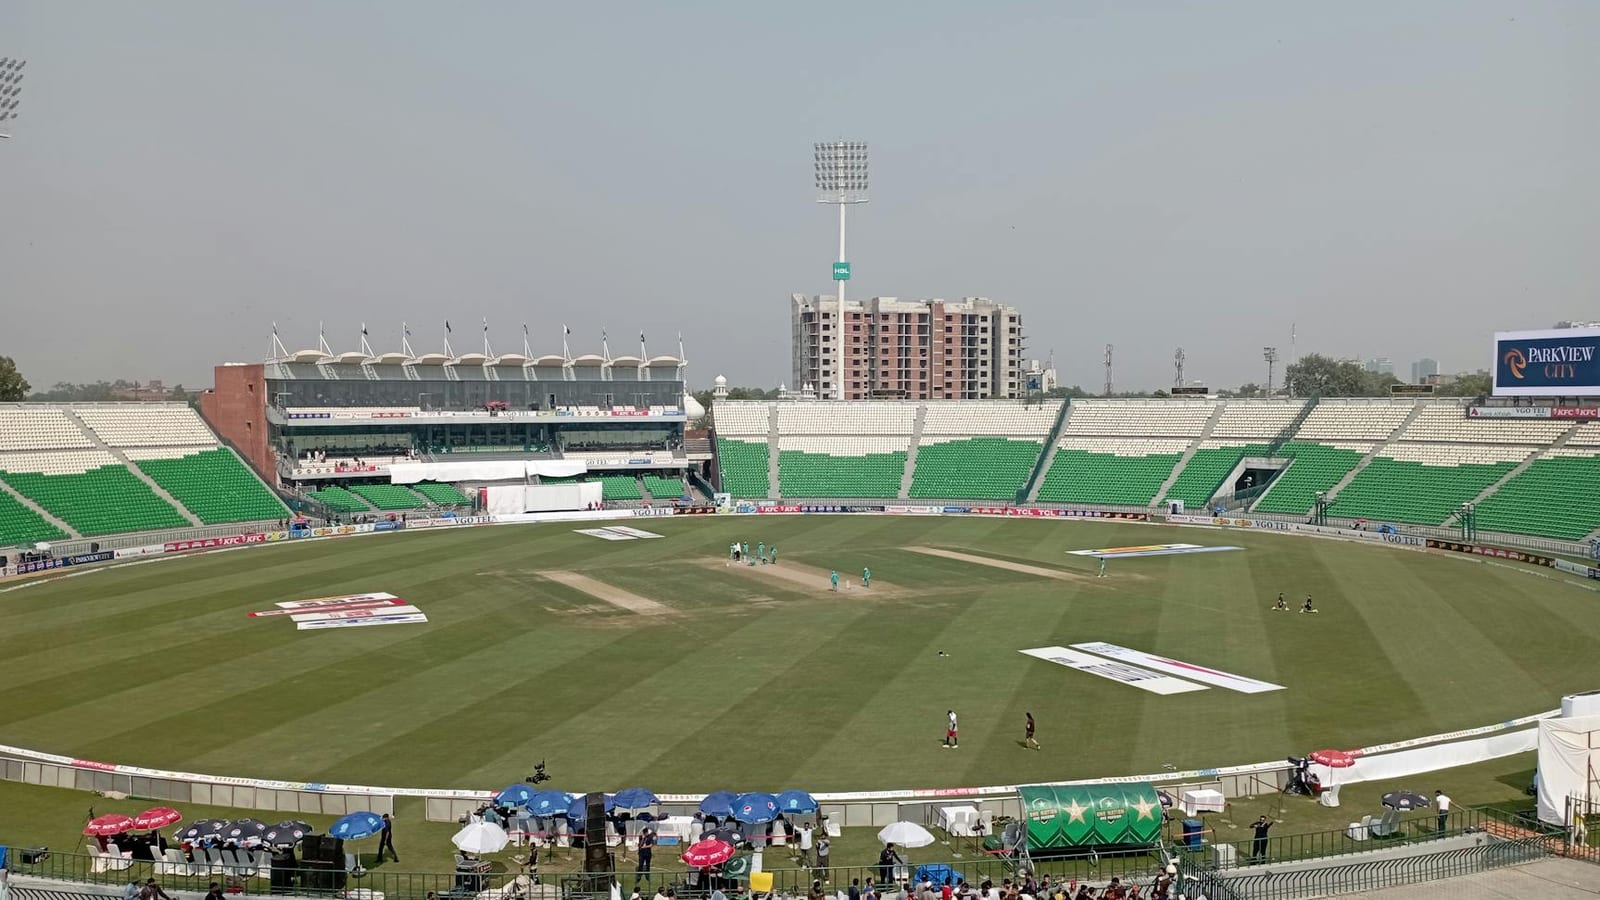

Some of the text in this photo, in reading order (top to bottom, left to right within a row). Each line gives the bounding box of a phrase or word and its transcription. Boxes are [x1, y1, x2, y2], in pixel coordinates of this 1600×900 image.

[1528, 346, 1595, 363] PARKVIEW
[1544, 364, 1576, 378] CITY
[632, 508, 651, 516] VGO
[454, 516, 474, 525] VGO
[477, 515, 491, 523] TEL
[1255, 520, 1274, 529] VGO
[1276, 522, 1290, 530] TEL
[223, 537, 240, 545] KFC
[246, 535, 263, 543] KFC
[1382, 533, 1401, 543] VGO
[1403, 536, 1420, 546] TEL
[710, 851, 723, 860] KFC
